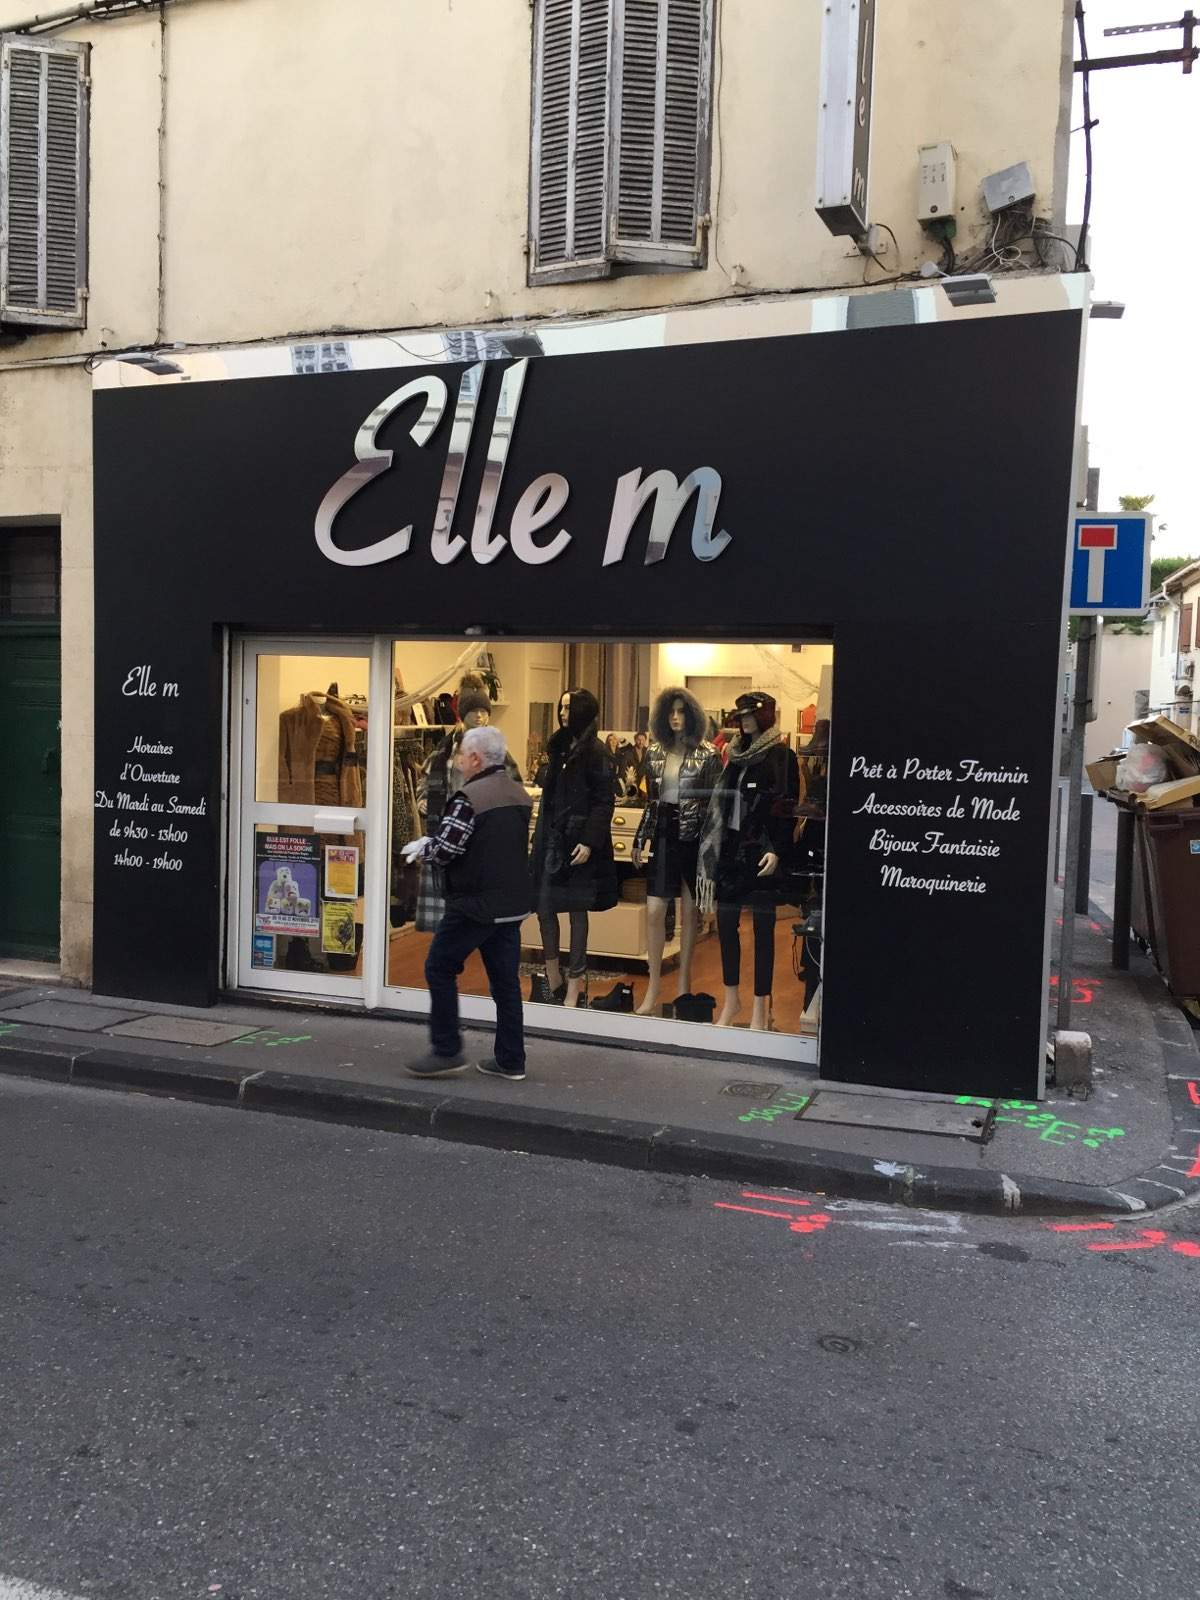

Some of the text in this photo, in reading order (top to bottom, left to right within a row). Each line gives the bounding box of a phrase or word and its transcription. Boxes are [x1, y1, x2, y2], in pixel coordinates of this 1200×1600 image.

[857, 0, 870, 127] le
[314, 357, 733, 568] Elle m
[121, 665, 180, 697] Elle m
[126, 735, 174, 755] Horaires
[119, 762, 181, 784] d'Ouverture
[849, 755, 1029, 784] Prêt à Porter Féminin
[94, 790, 206, 816] Du Mardi au Samedi
[852, 792, 1021, 821] Accessoires de Mode
[109, 819, 121, 837] de
[123, 820, 148, 839] 9h30
[158, 823, 188, 843] 13h00
[869, 828, 1001, 858] Bijoux Fantaisie
[113, 848, 143, 868] 14h00
[152, 851, 183, 871] 19h00
[880, 864, 987, 895] Maroquinerie
